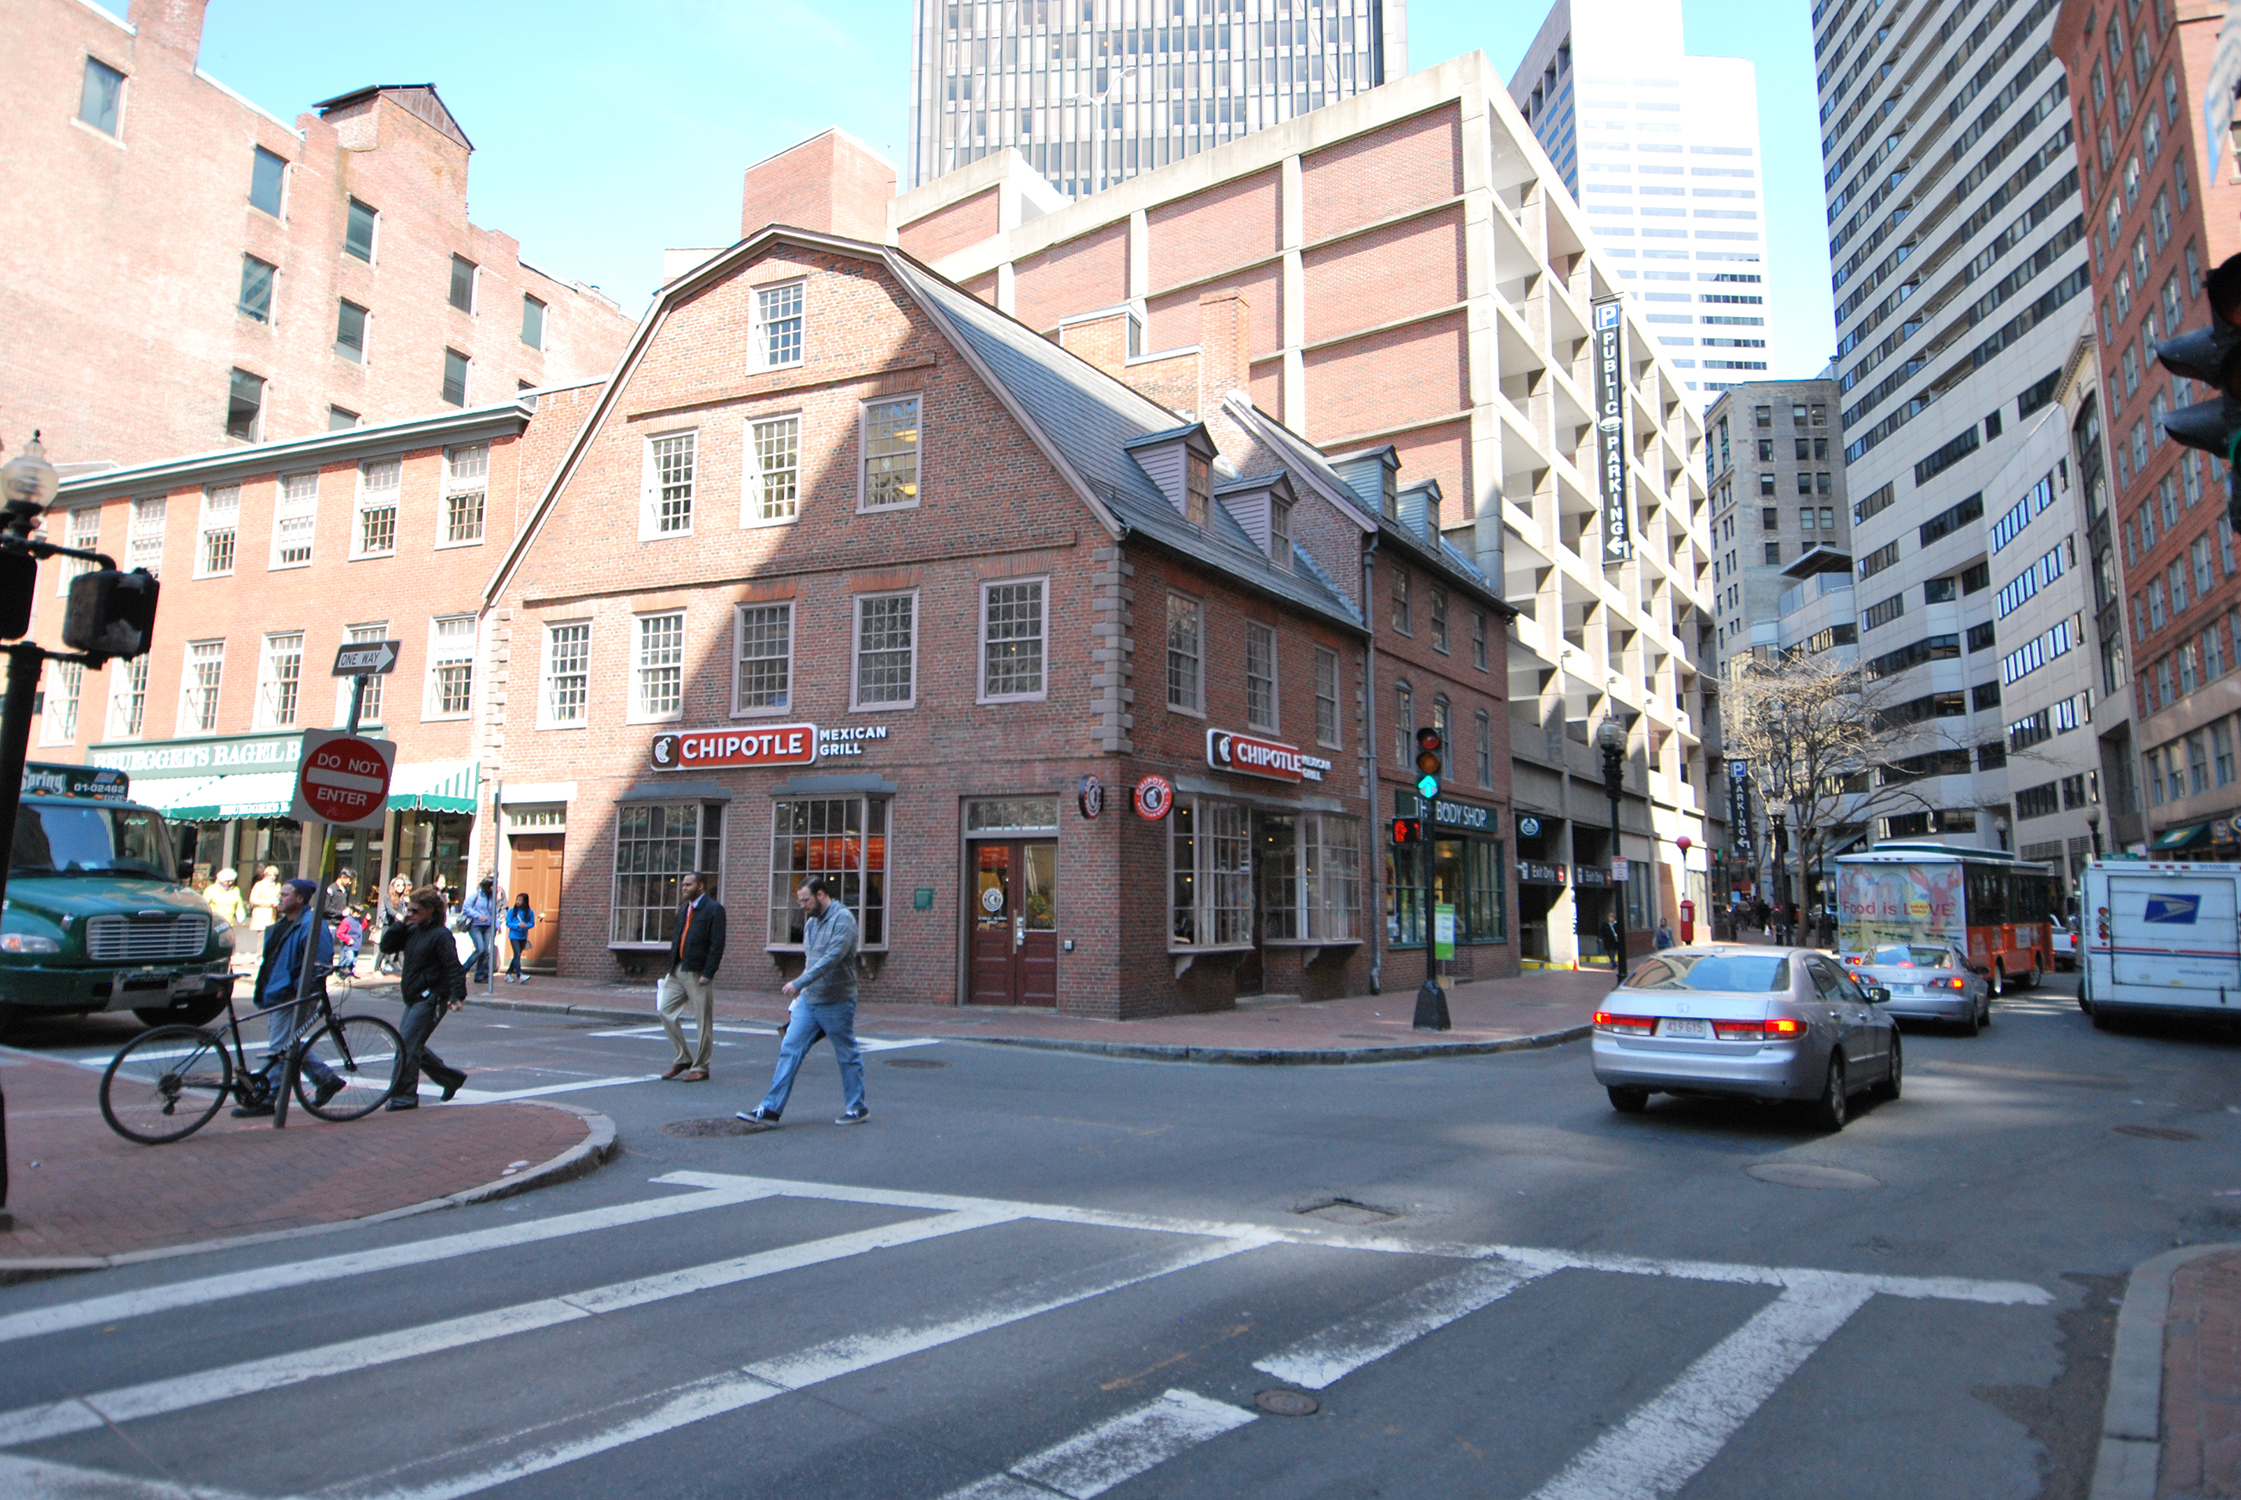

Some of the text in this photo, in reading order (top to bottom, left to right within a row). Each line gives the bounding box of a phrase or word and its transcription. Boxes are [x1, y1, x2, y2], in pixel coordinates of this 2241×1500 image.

[1601, 306, 1616, 326] P
[1603, 332, 1618, 414] PUBLIC
[1607, 435, 1624, 535] PARKING
[341, 651, 381, 666] ONE WAY
[819, 726, 887, 742] MEXICAN
[211, 742, 285, 766] BAGEL
[682, 733, 804, 760] CHIPOTLE
[819, 743, 862, 757] GRILL
[317, 753, 381, 775] DO NOT
[1237, 743, 1302, 772] CHIPOTLE
[1733, 762, 1744, 777] P
[1136, 777, 1170, 796] CHIPOTLE
[316, 787, 367, 807] ENTER
[1735, 776, 1748, 835] PARKING
[1435, 800, 1462, 824] BODY
[1531, 864, 1555, 882] Exit Only
[1842, 901, 1876, 915] Food
[1882, 902, 1898, 916] is
